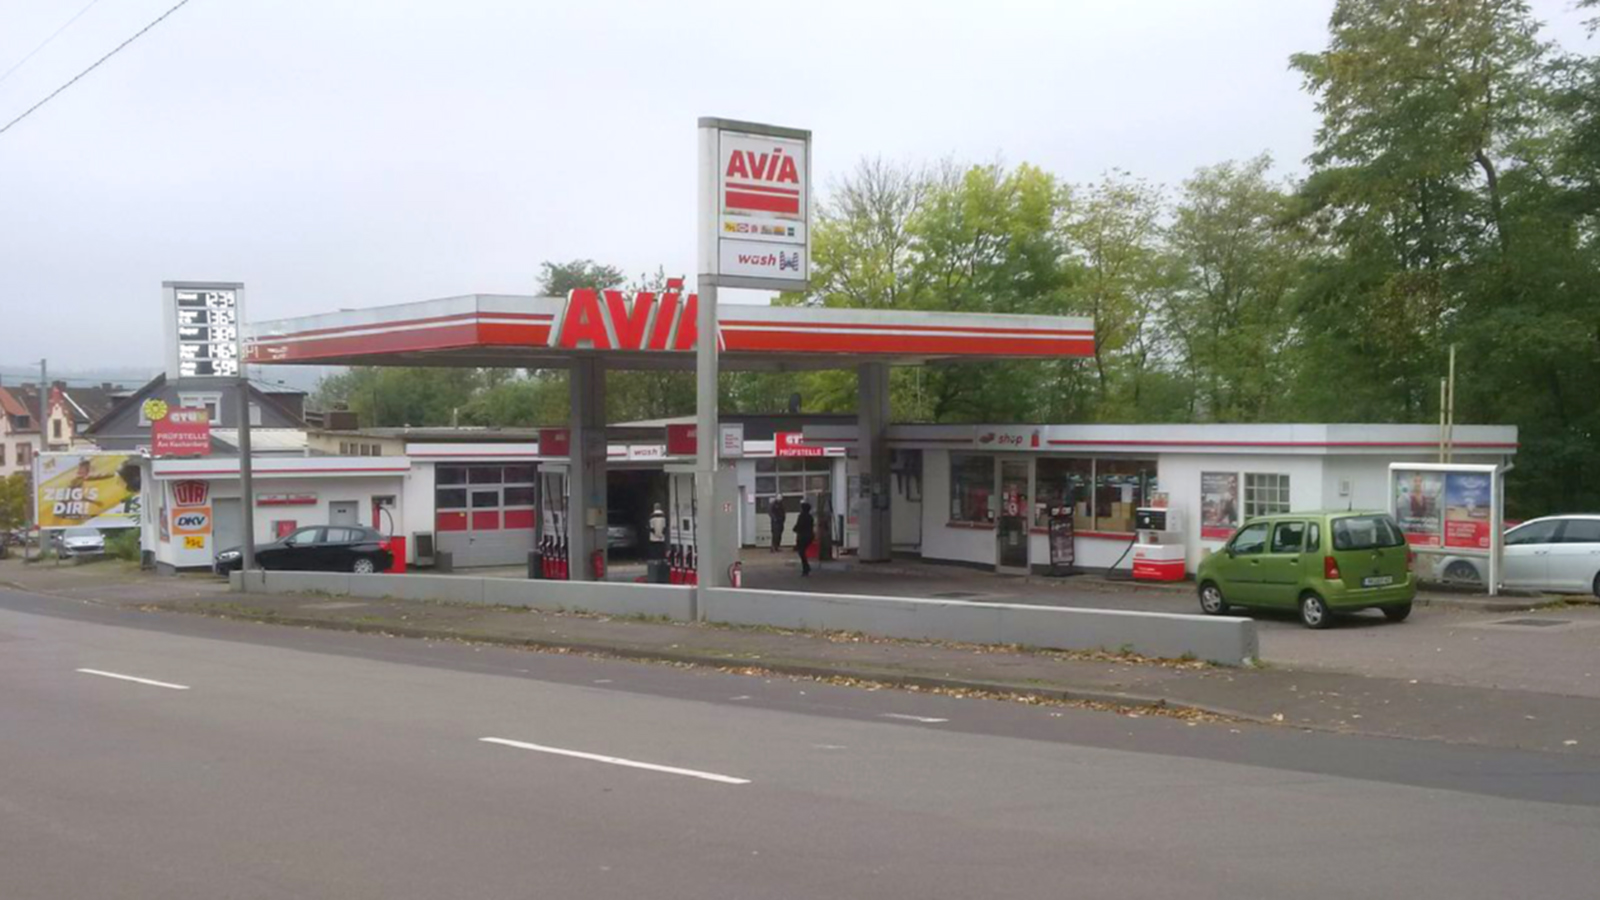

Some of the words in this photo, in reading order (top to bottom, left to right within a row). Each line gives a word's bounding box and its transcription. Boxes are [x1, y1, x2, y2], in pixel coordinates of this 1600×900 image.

[726, 147, 799, 184] AVIA
[738, 254, 776, 266] wash
[156, 432, 208, 440] PRÜFSTELLE
[997, 433, 1023, 447] shop
[633, 448, 658, 456] wash
[779, 447, 822, 456] PRÜFSTELLE
[43, 487, 99, 501] ZEIG'S
[177, 484, 204, 503] UTA
[53, 501, 89, 515] DIR!
[177, 516, 206, 526] DKV
